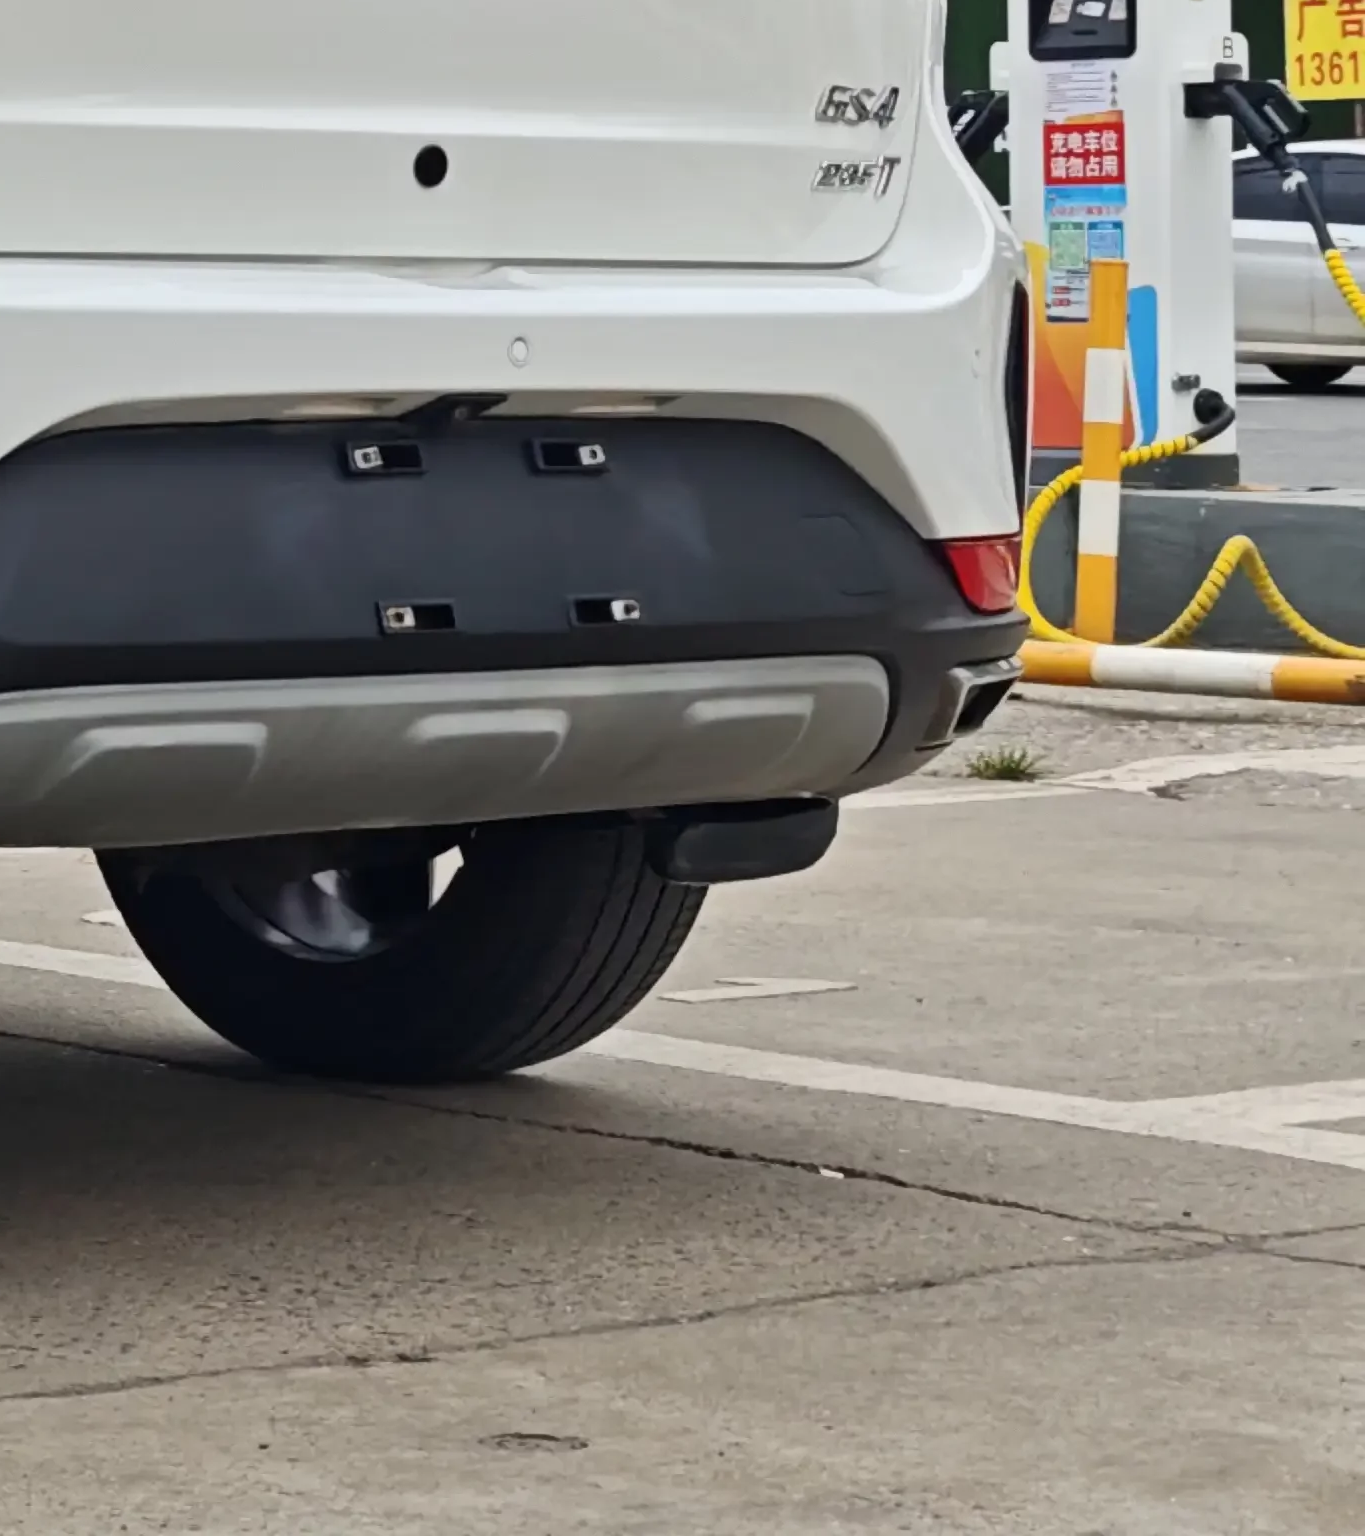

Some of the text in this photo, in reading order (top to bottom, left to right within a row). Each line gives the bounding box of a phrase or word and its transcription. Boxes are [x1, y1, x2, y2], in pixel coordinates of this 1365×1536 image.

[1222, 36, 1235, 59] B
[1050, 129, 1118, 154] 充电车位
